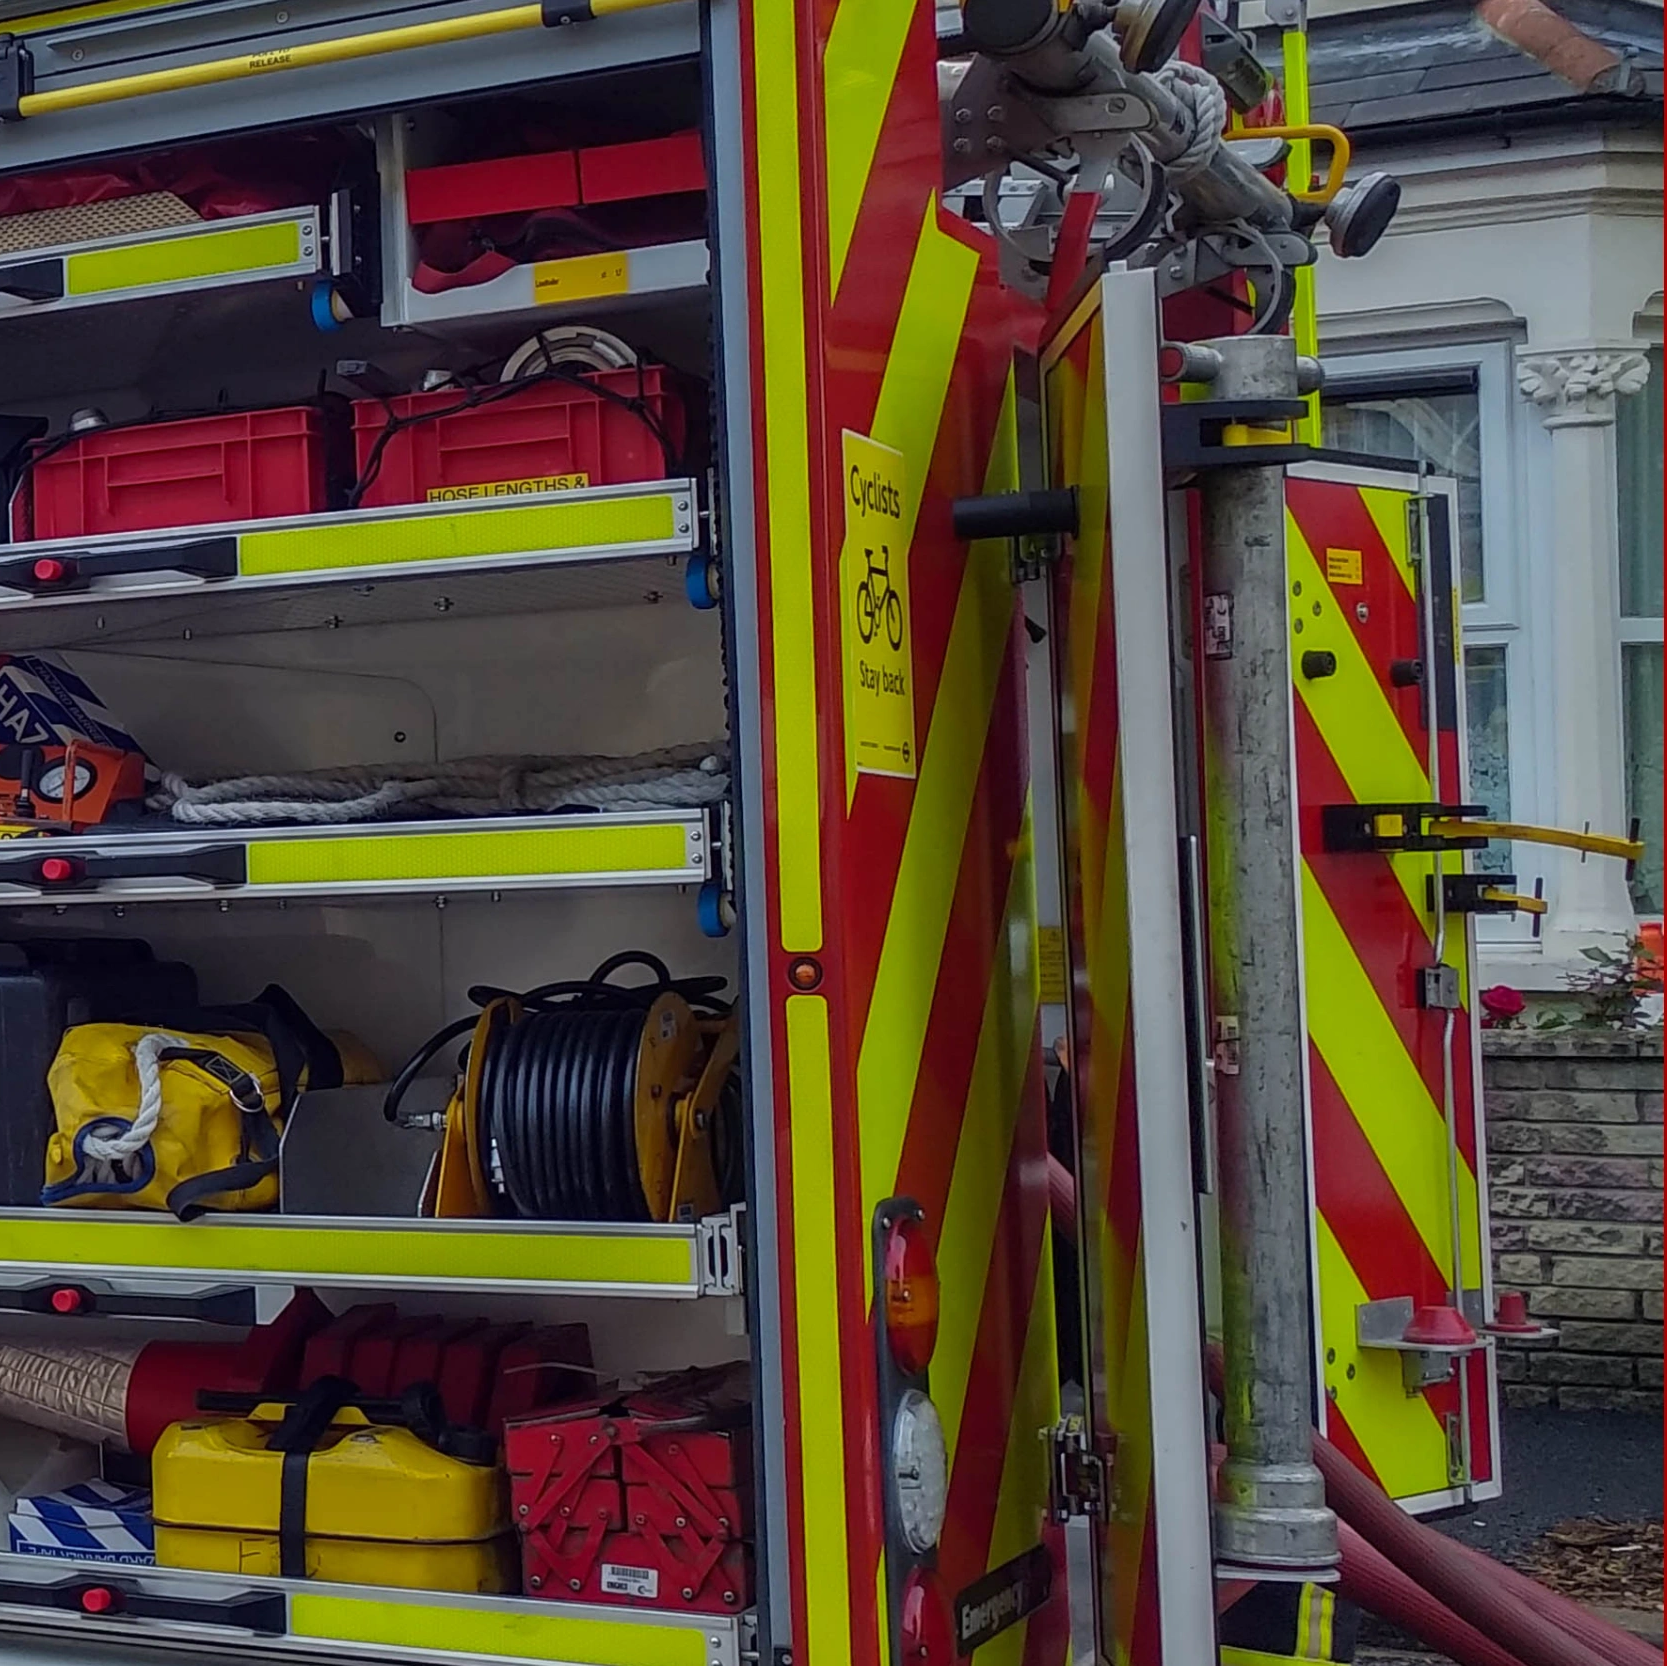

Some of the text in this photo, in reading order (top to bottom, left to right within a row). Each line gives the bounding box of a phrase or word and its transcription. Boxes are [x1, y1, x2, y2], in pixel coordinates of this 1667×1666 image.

[249, 54, 291, 69] RELEASE
[850, 464, 901, 519] Cyclists
[859, 660, 906, 697] Stay back
[961, 1580, 1024, 1641] Emergency
